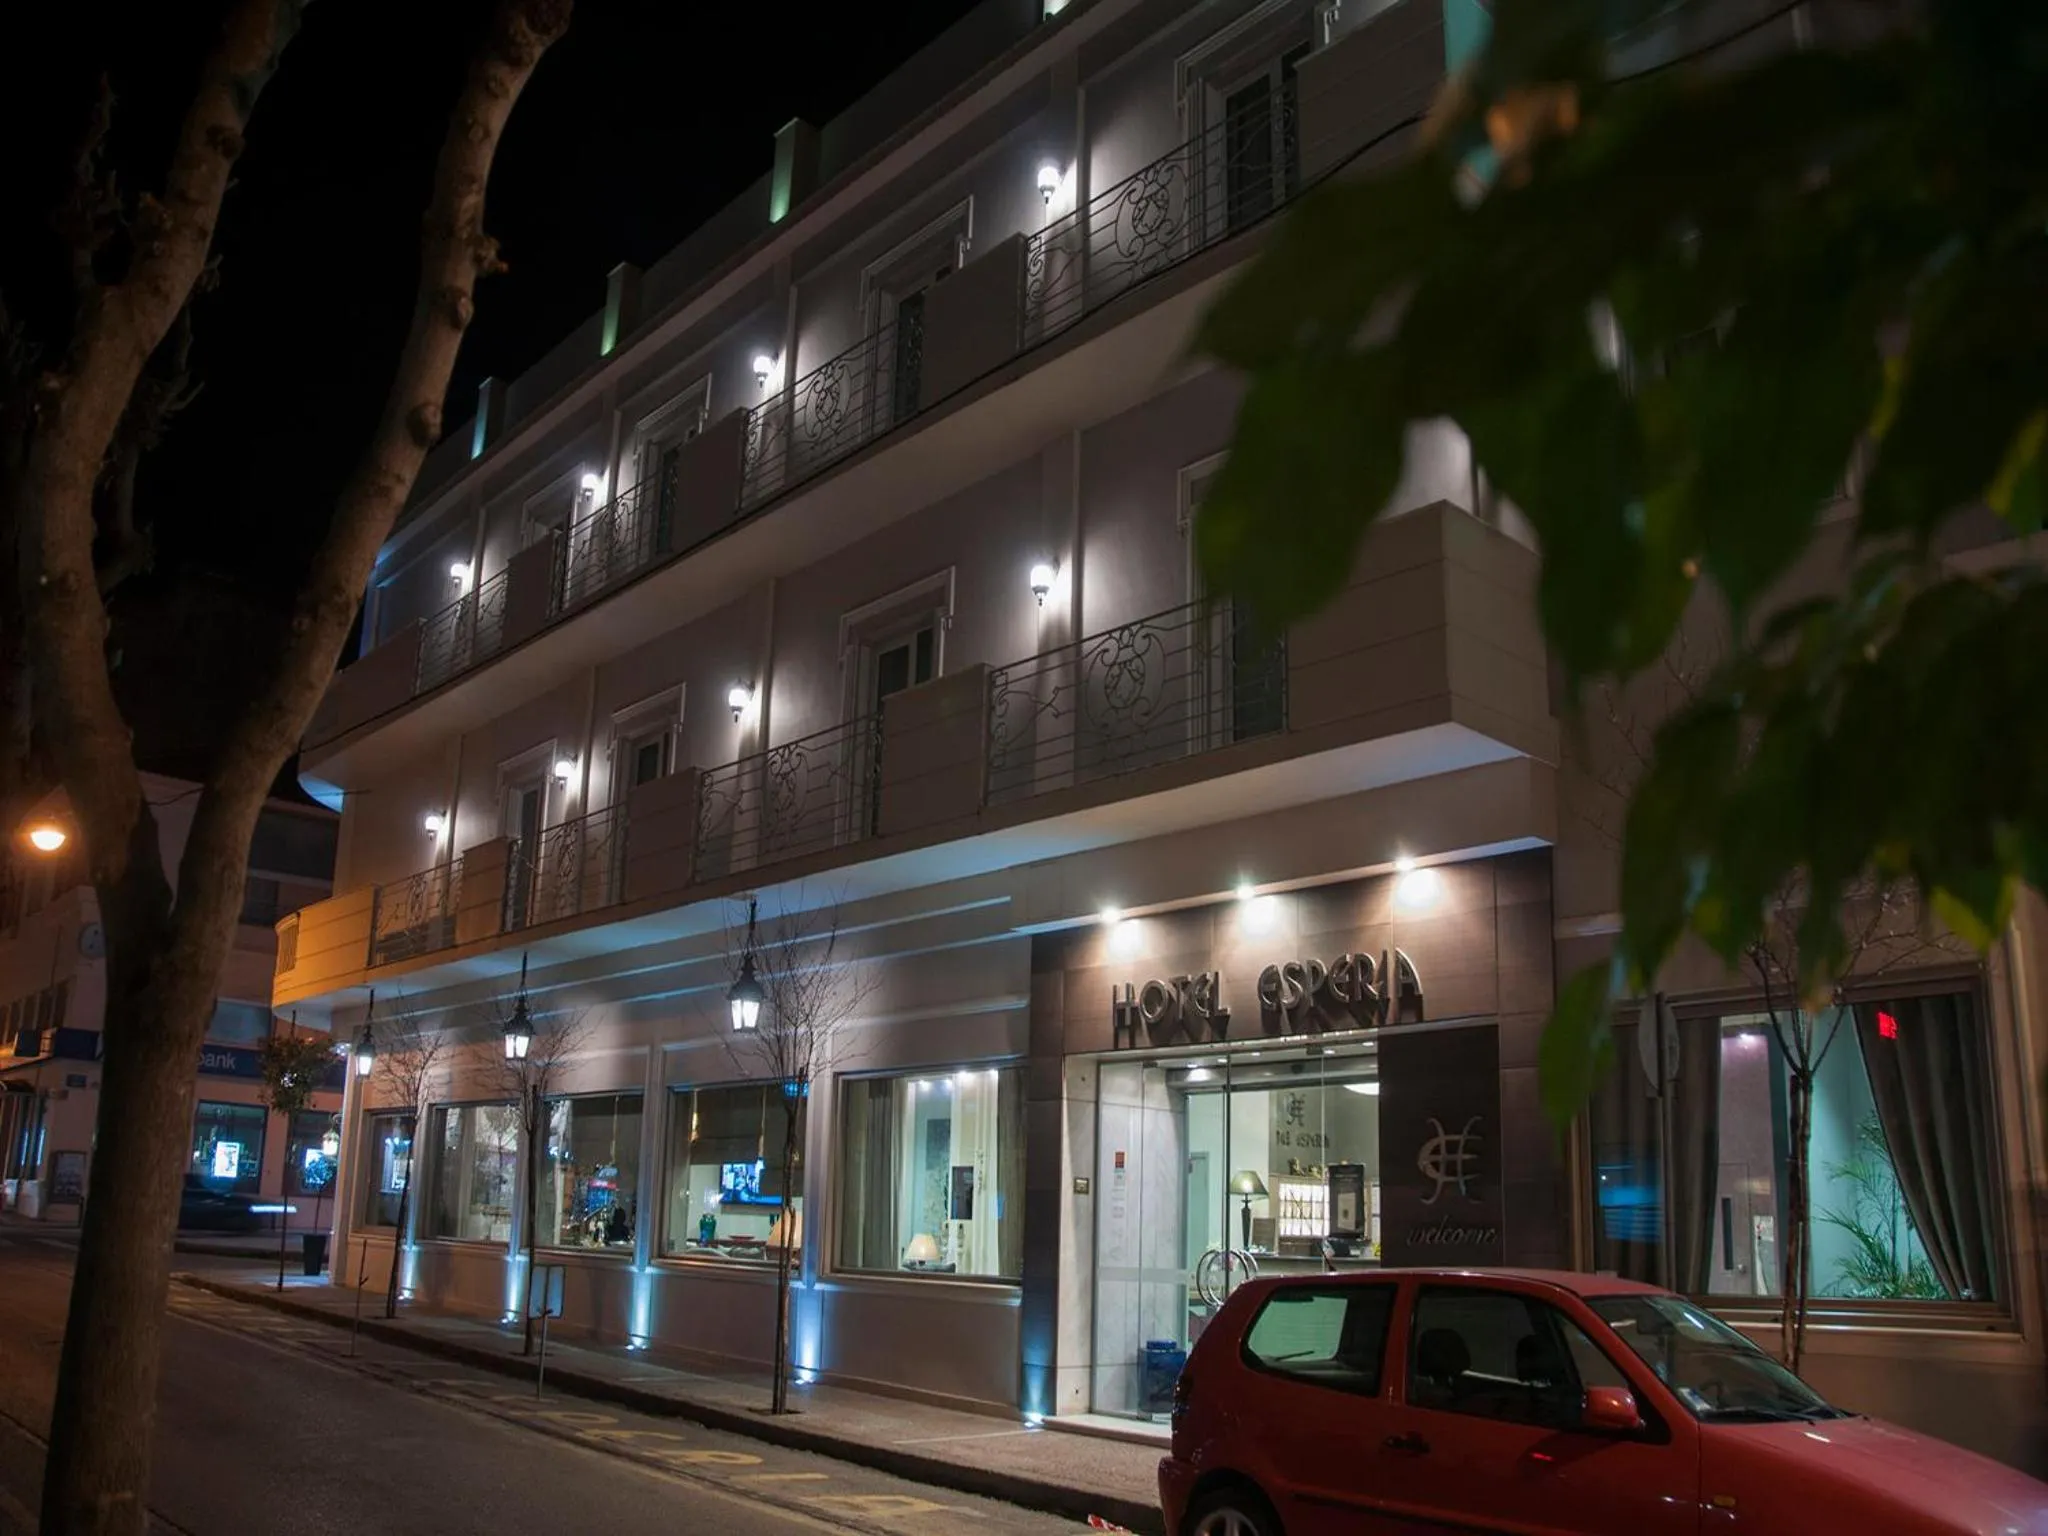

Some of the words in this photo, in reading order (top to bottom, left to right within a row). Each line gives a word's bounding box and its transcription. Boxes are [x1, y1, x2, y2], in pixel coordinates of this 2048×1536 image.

[1112, 970, 1232, 1028] HOTEL
[1257, 947, 1424, 1010] ESPERIA
[1406, 1213, 1498, 1247] welcome
